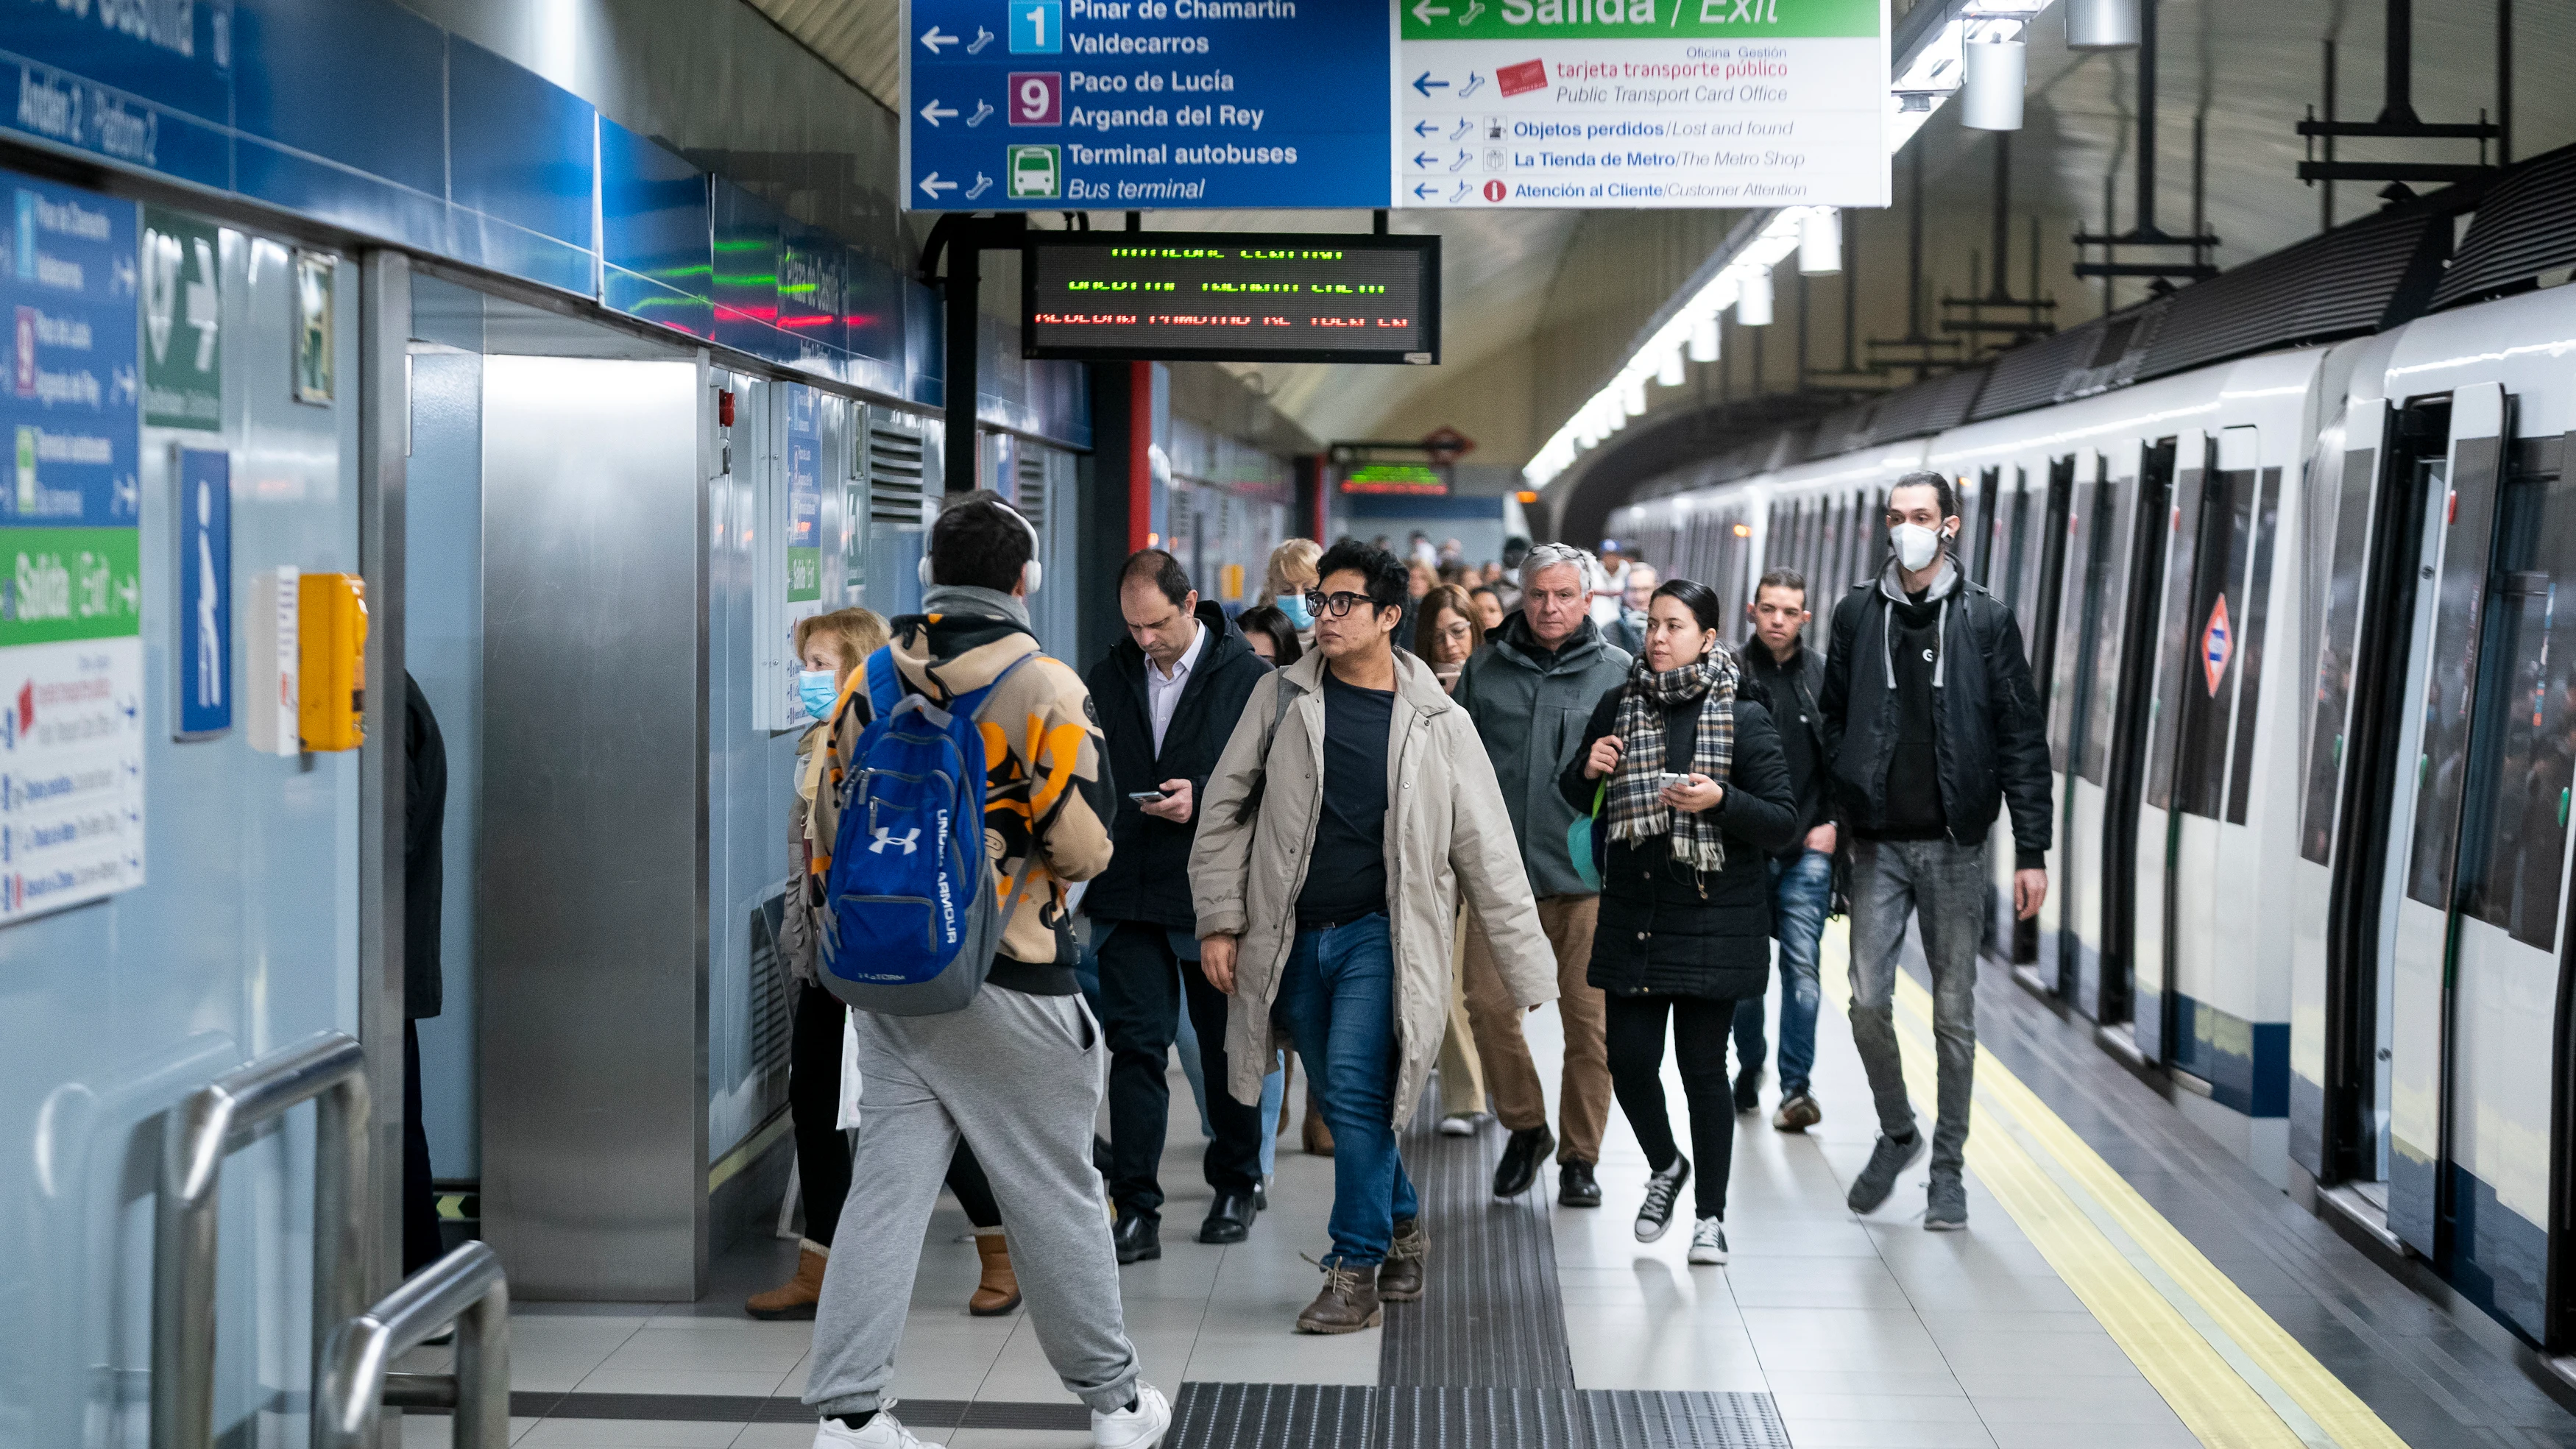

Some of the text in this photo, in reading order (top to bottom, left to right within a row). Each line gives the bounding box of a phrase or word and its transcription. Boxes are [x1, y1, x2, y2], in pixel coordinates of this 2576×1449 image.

[1070, 0, 1131, 20] Pinar
[1138, 0, 1167, 20] de
[1026, 6, 1044, 47] 1
[1069, 32, 1209, 54] Valdecarros
[1686, 46, 1787, 60] Oficina Gestión
[1069, 68, 1234, 93] Paco de Lucía
[1557, 59, 1788, 82] tarjeta transporte público
[1020, 79, 1050, 121] 9
[1556, 85, 1608, 103] Public
[1614, 85, 1691, 107] Transport
[1694, 84, 1735, 102] Card
[1739, 84, 1788, 102] Office
[1069, 104, 1264, 132] Arganda del Rey
[1514, 121, 1582, 141] Objetos
[1711, 121, 1744, 136] and
[1747, 120, 1794, 136] found
[1068, 143, 1298, 165] Terminal autobuses
[1515, 151, 1535, 167] La
[1539, 151, 1596, 167] Tienda
[1601, 151, 1622, 167] de
[1713, 149, 1760, 167] Metro
[1763, 149, 1805, 169] Shop
[1068, 177, 1206, 200] Bus terminal
[1515, 182, 1585, 198] Atención
[1589, 183, 1604, 198] al
[1742, 181, 1808, 198] Attention
[937, 871, 957, 944] ARMOUR
